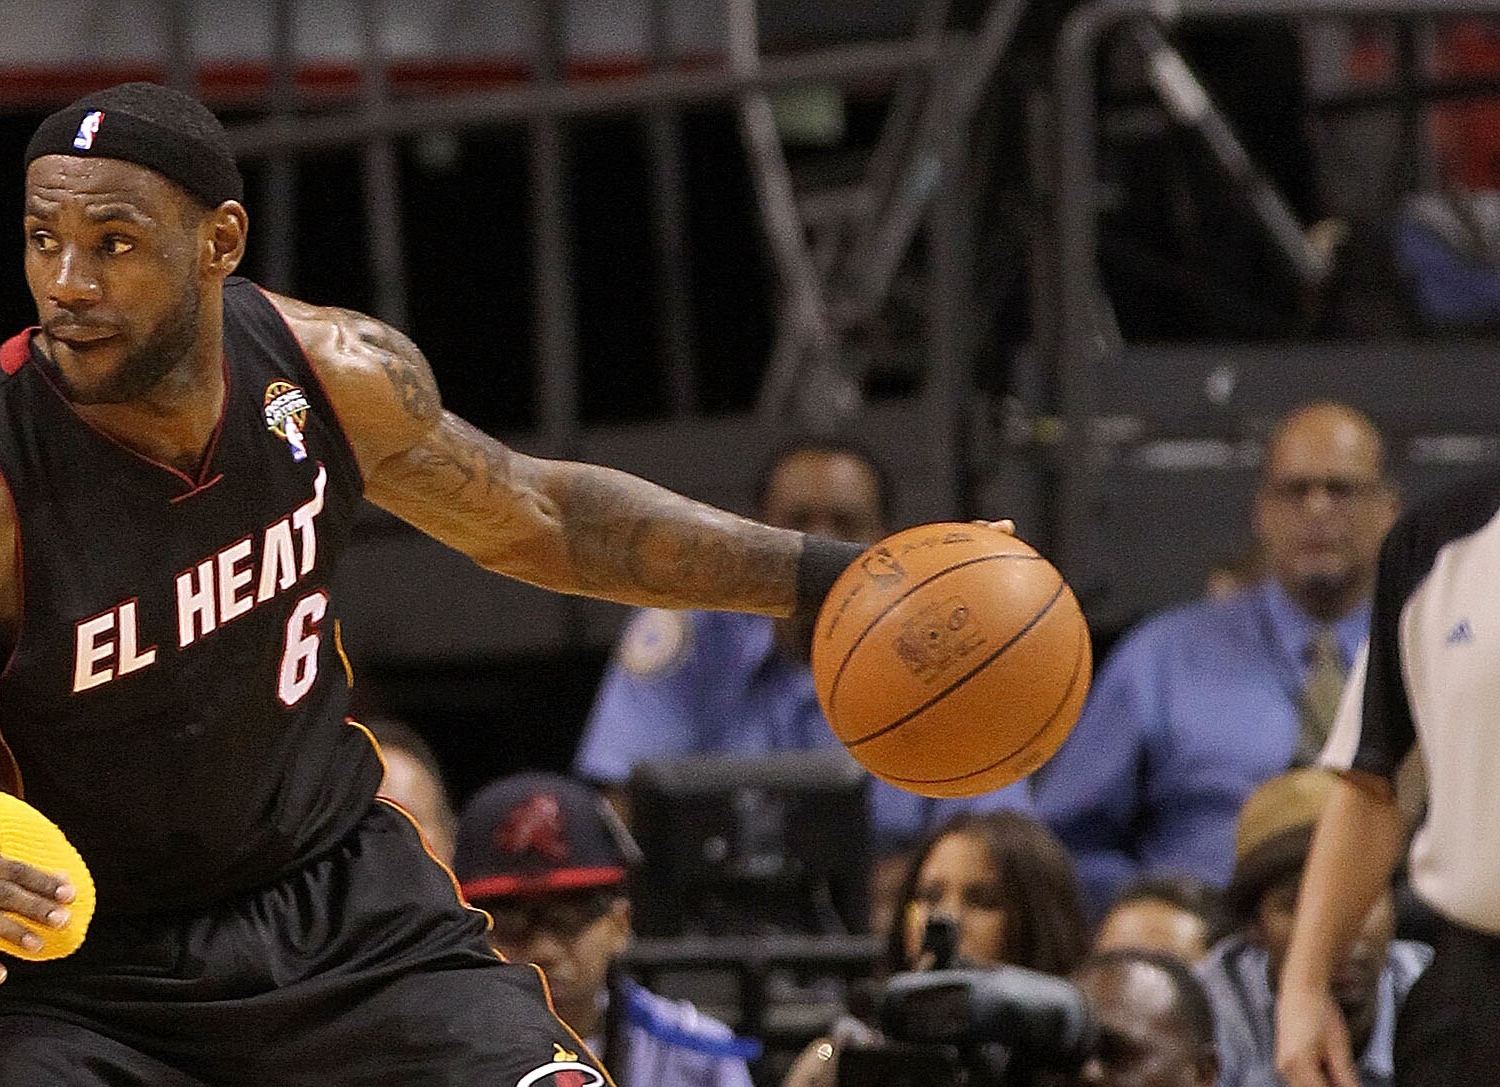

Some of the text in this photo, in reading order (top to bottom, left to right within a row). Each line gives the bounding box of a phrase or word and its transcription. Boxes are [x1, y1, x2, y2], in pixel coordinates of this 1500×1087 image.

[72, 461, 328, 694] EL HEAT
[277, 588, 328, 709] 6
